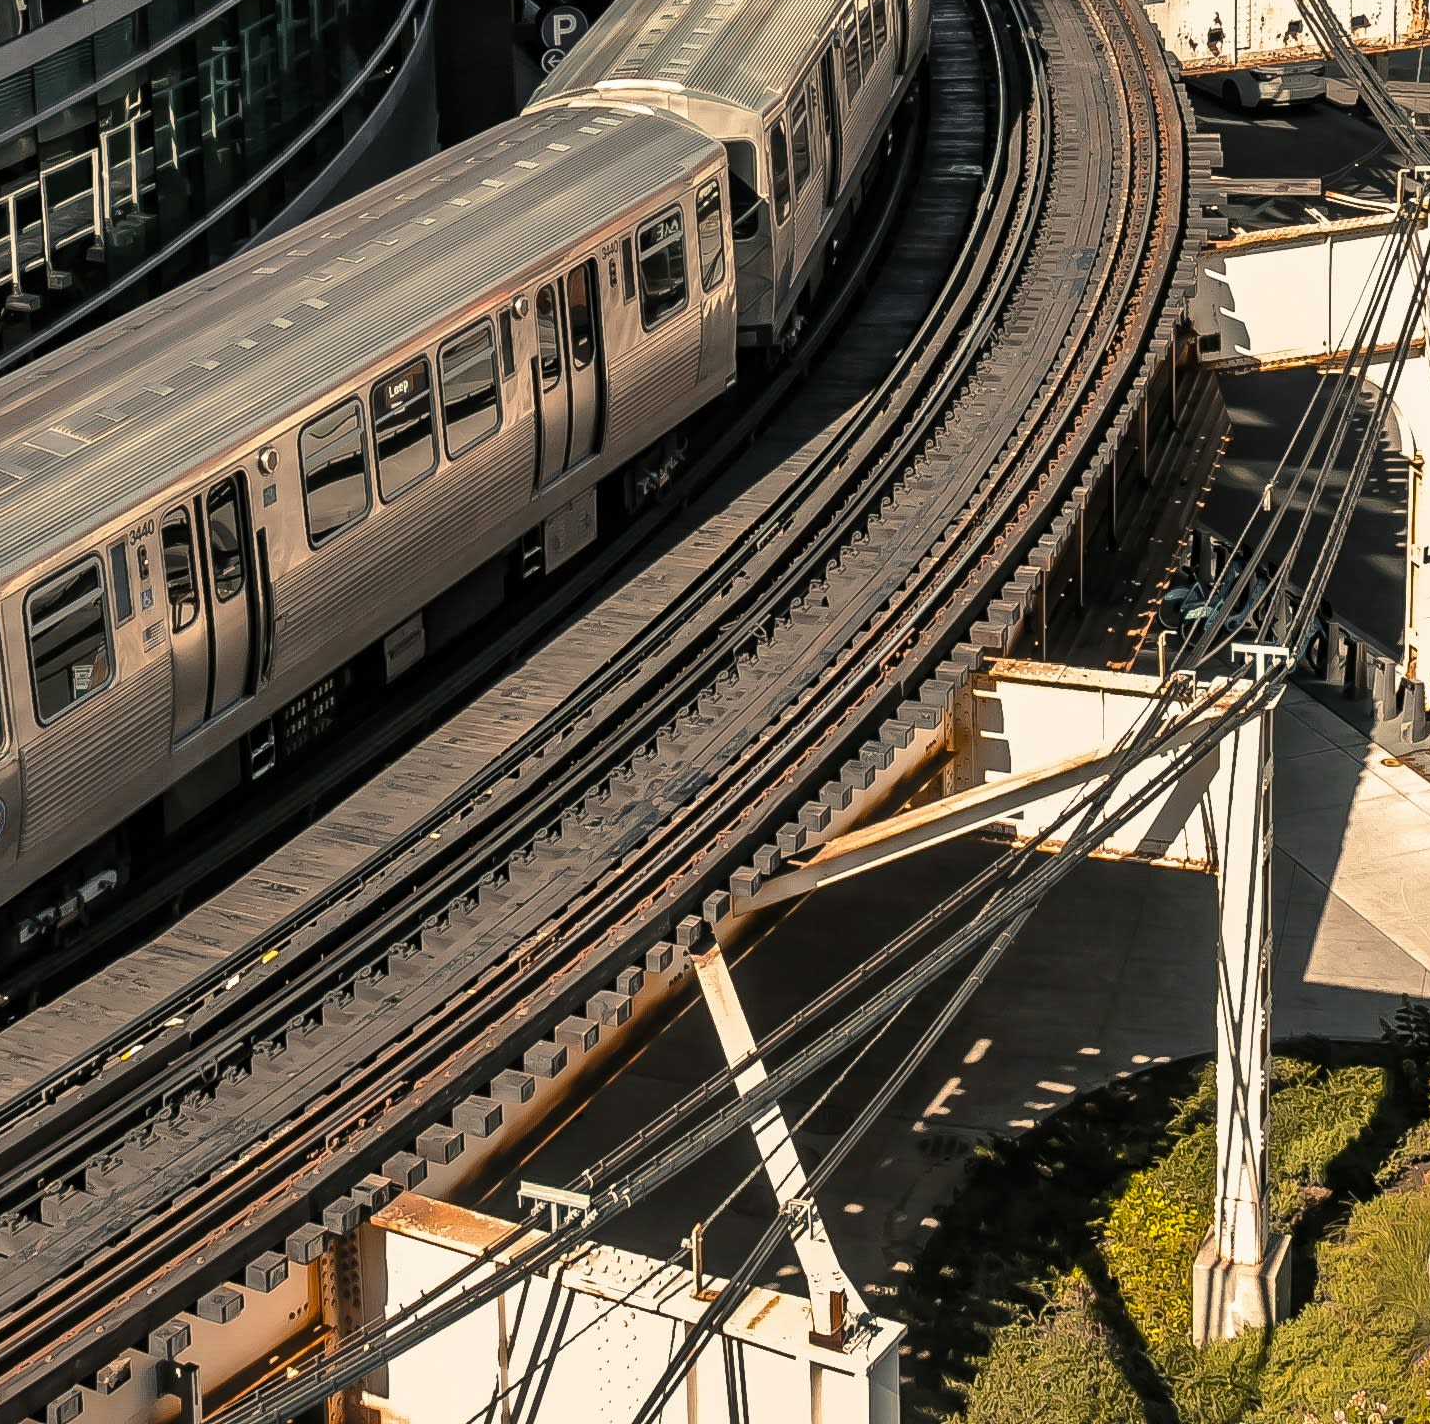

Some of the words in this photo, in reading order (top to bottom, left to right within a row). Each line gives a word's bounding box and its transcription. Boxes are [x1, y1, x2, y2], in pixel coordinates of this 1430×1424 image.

[553, 14, 577, 46] P
[388, 379, 409, 399] Loop
[129, 519, 155, 546] 3440
